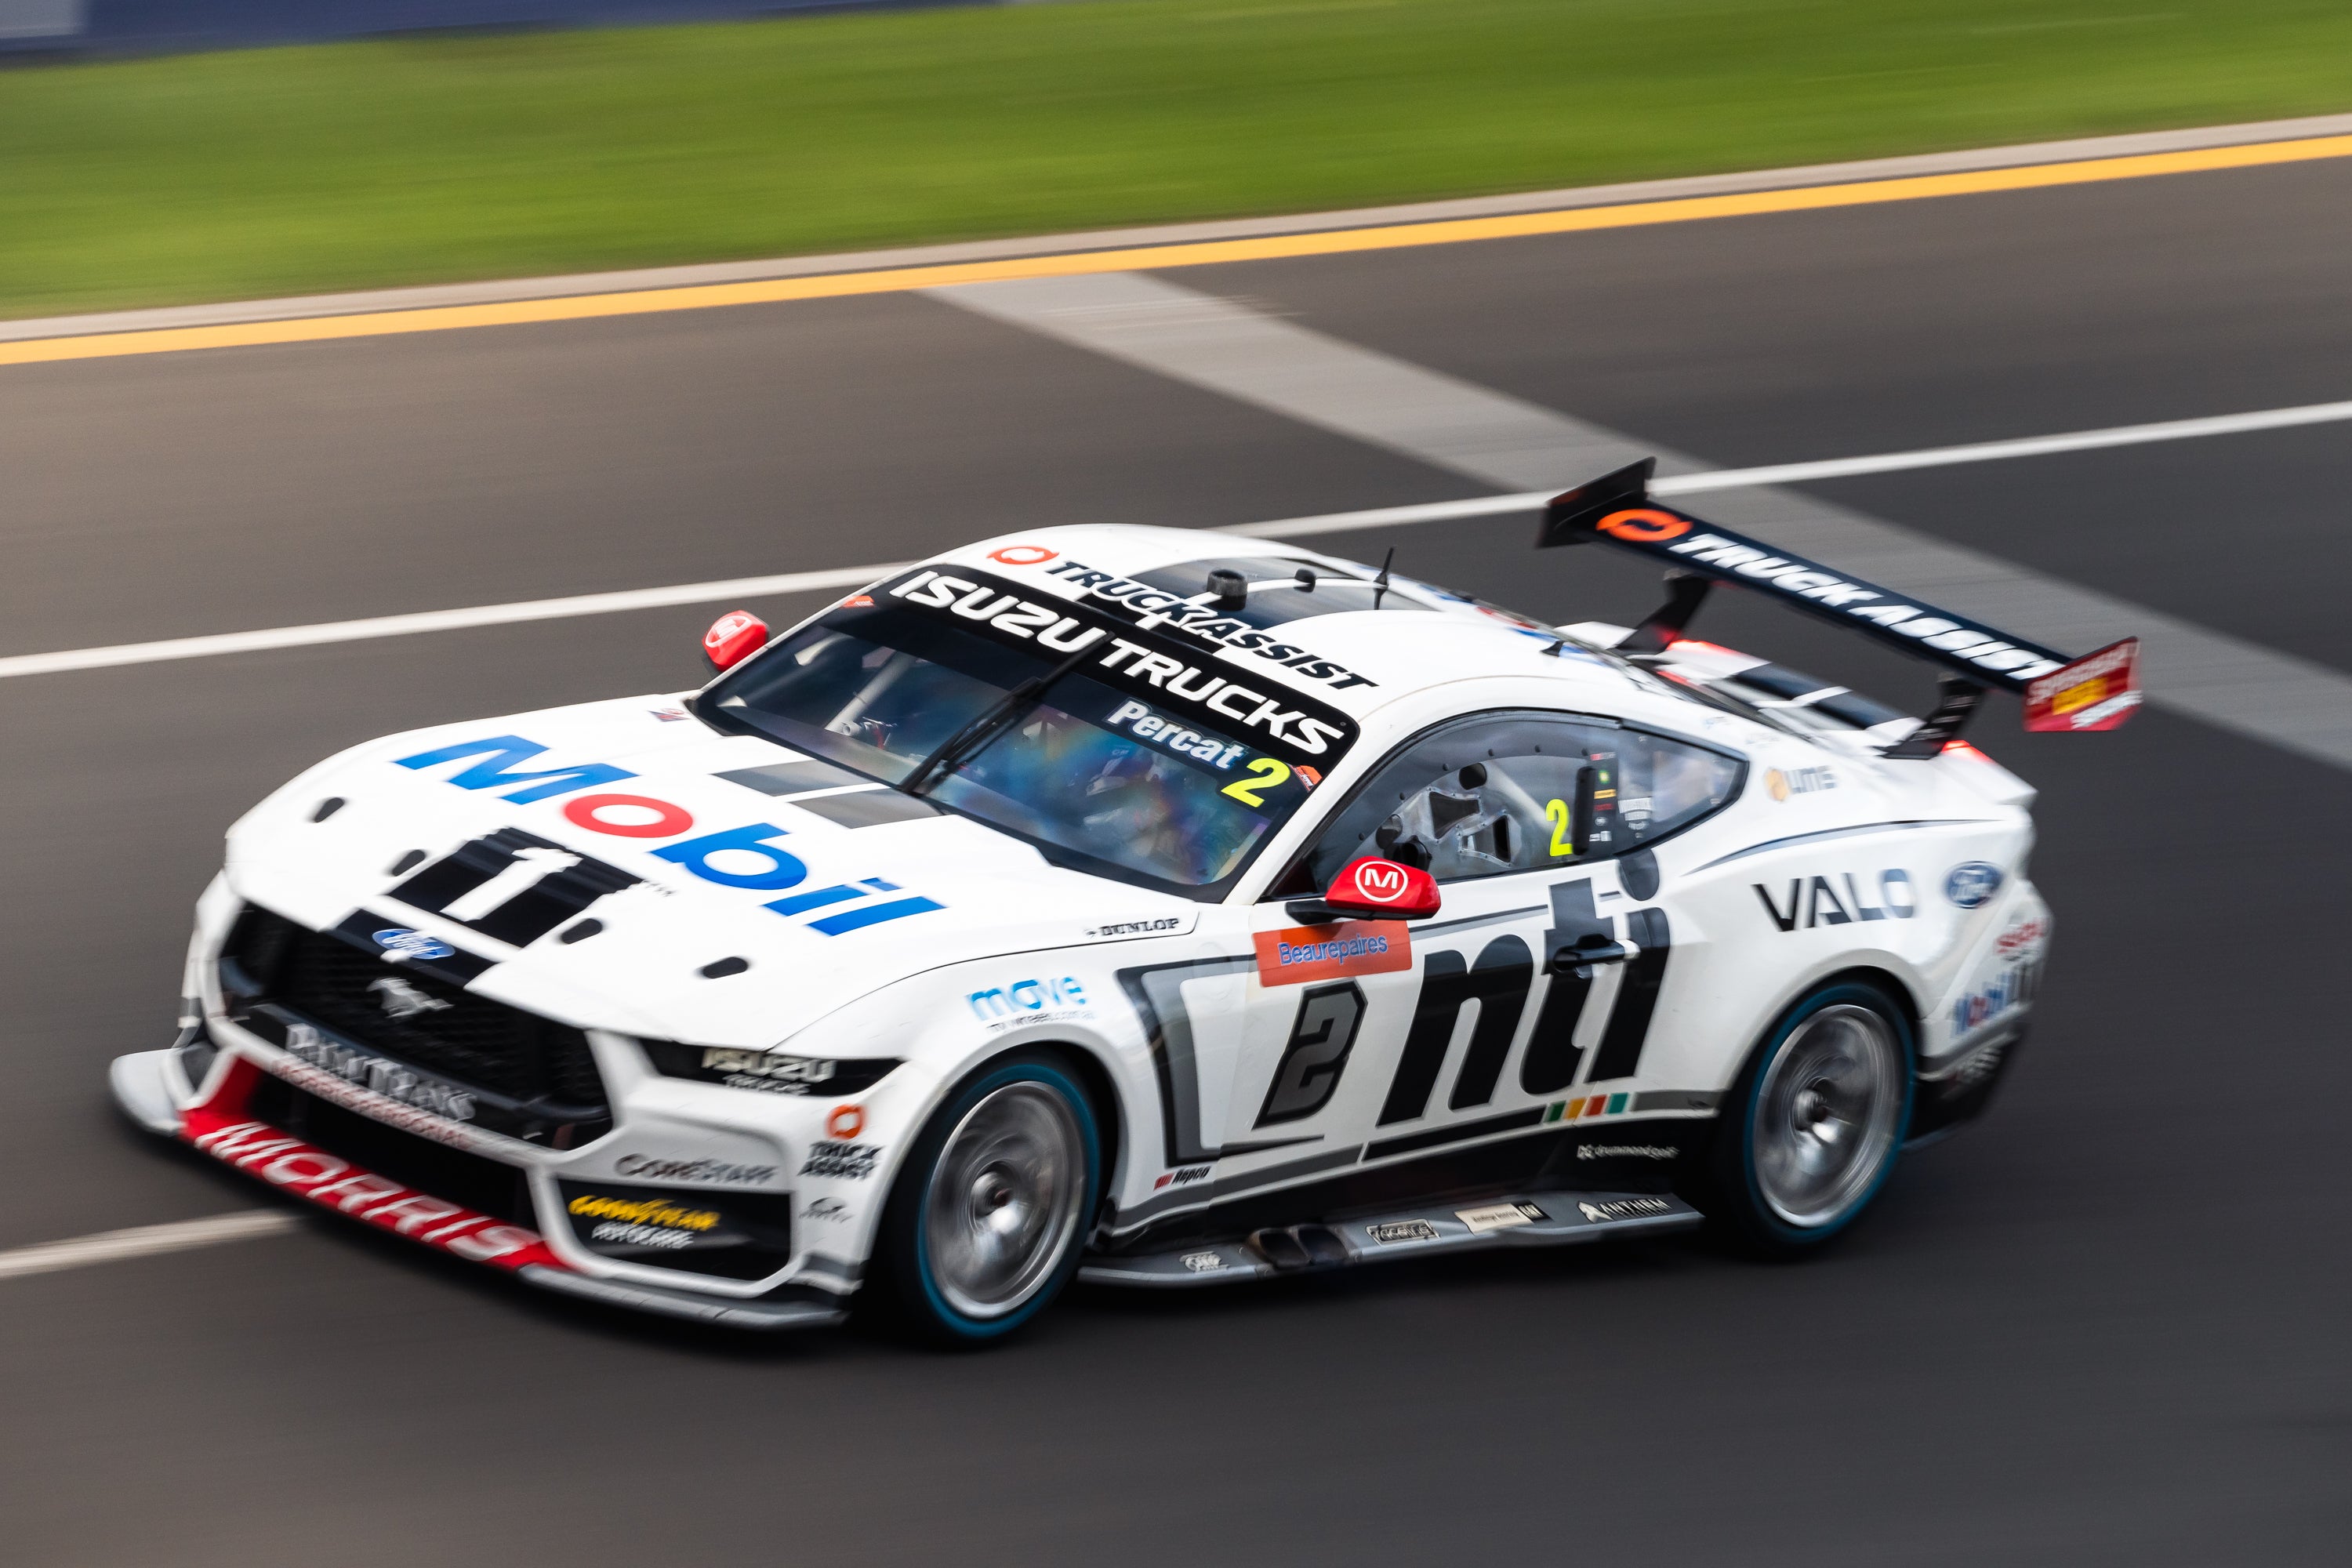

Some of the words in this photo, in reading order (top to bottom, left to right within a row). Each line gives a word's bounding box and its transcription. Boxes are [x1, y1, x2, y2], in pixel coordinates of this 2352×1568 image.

[1667, 533, 1884, 607] TRUCK
[1847, 604, 2067, 680] ASSIST
[889, 570, 1108, 653] ISUZU
[1098, 637, 1345, 754] TRUCKS
[1106, 700, 1246, 770] Percat
[1220, 757, 1291, 808] 2
[390, 735, 950, 937] Mobil
[1544, 798, 1574, 857] 2
[439, 846, 584, 922] 1
[1098, 917, 1179, 936] DUNLOP
[1277, 933, 1388, 965] Beaurepaires
[964, 976, 1088, 1022] move
[1374, 847, 1671, 1127] nti
[701, 1048, 838, 1083] ISUZU
[1252, 978, 1369, 1130] 2
[193, 1120, 544, 1261] MORRIS
[1598, 1197, 1672, 1218] ANTHEM
